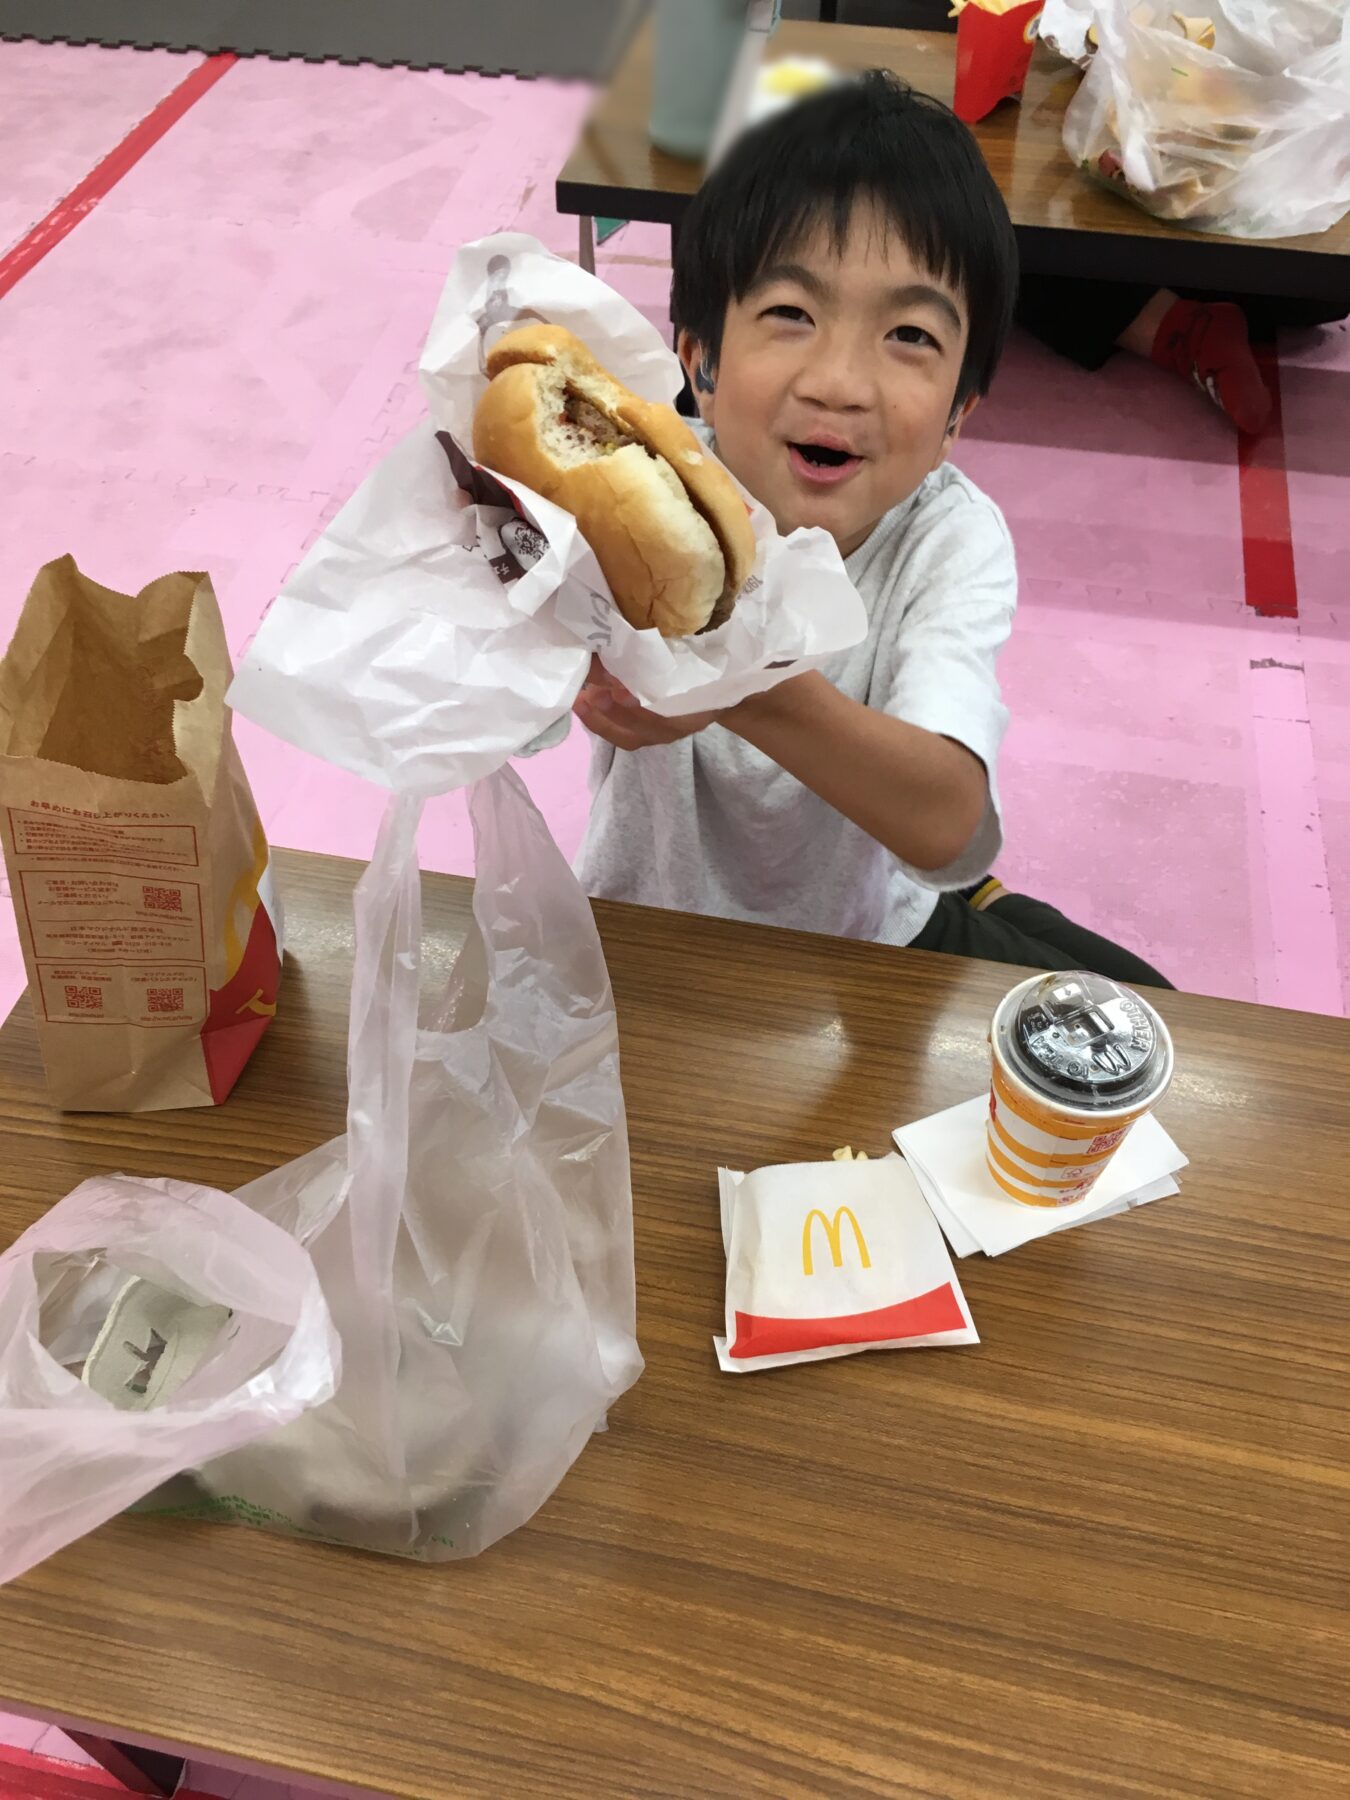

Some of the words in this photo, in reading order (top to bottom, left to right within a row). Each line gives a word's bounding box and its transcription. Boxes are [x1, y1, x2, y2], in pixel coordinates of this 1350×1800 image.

[30, 800, 171, 819] お早めにお召し上がりください
